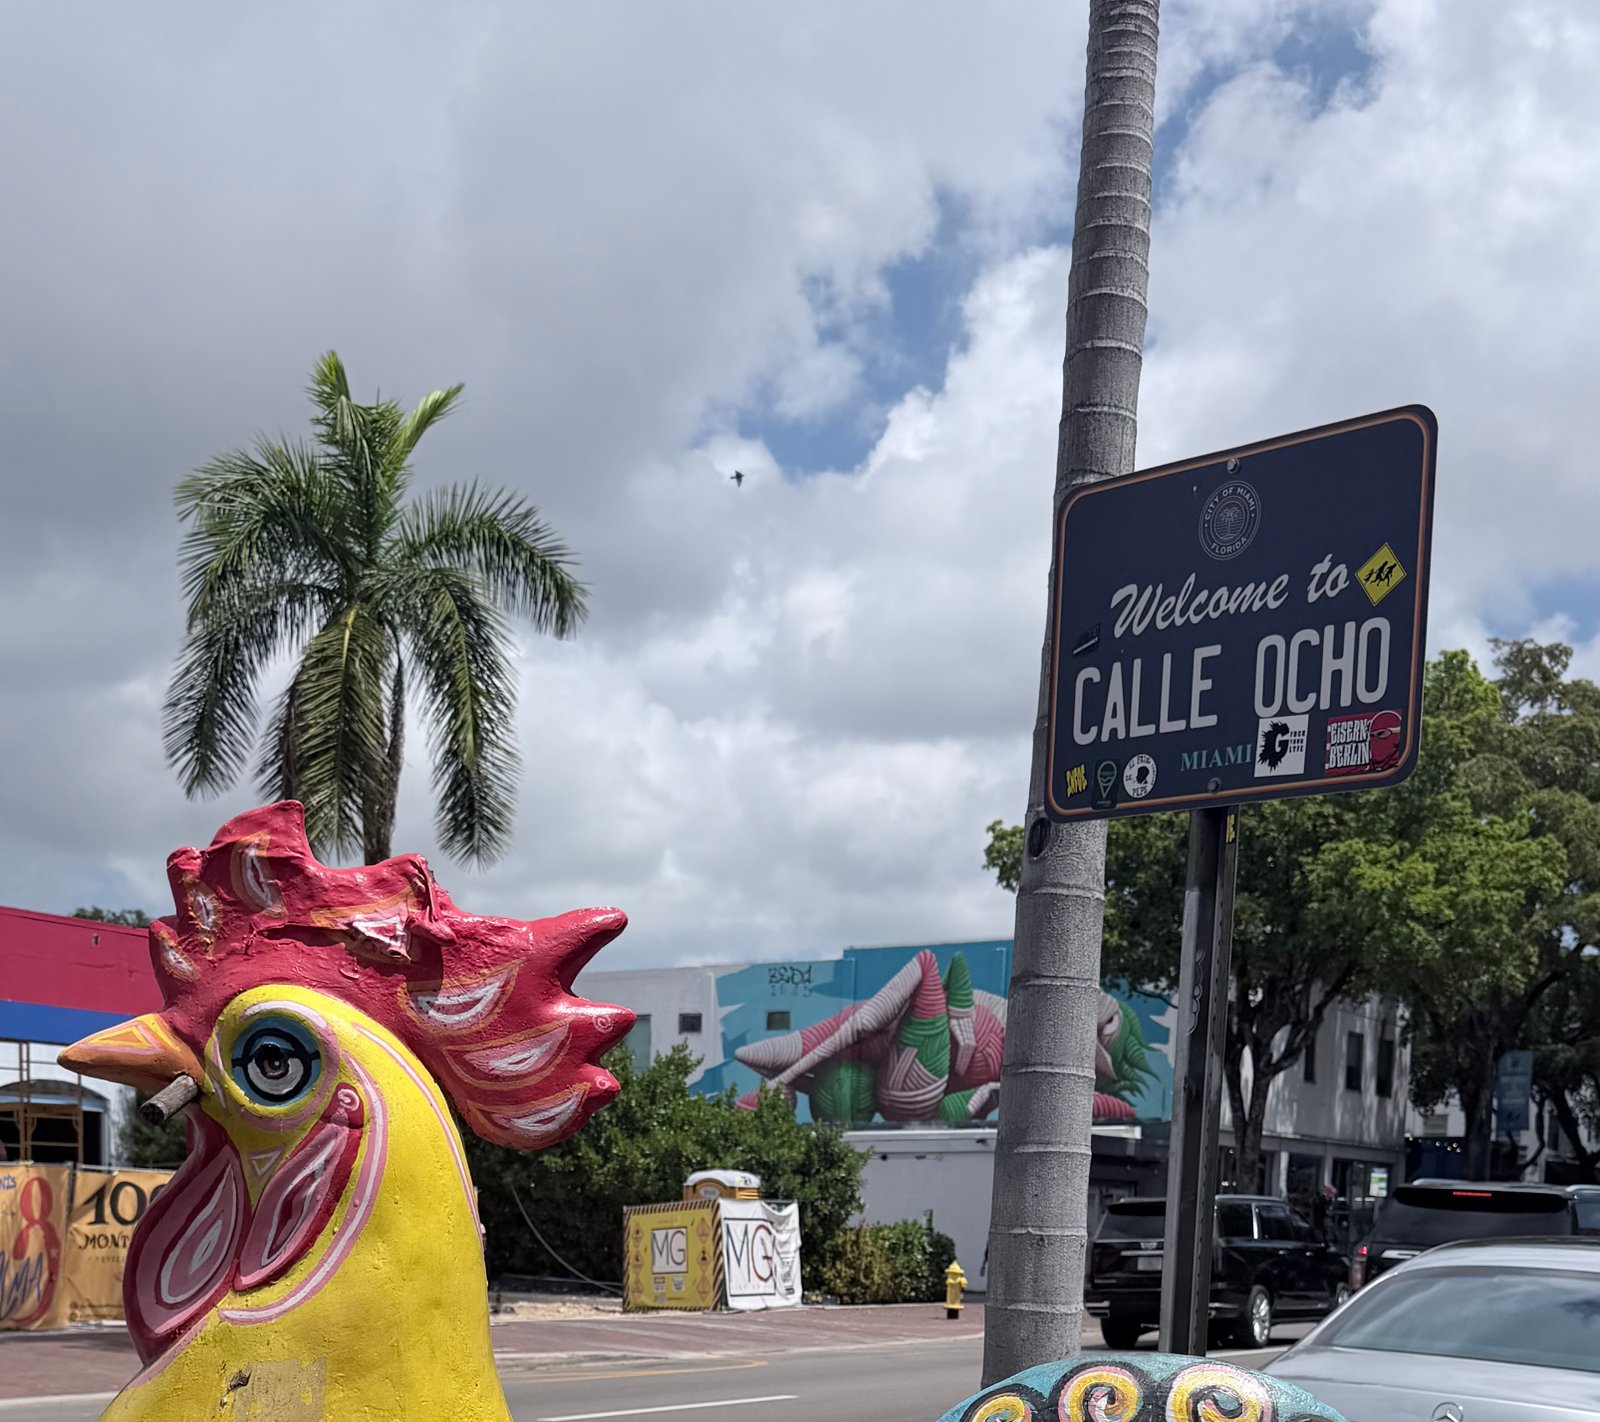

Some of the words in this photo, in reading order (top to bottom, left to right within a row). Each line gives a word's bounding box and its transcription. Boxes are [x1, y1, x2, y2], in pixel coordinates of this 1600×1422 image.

[1204, 496, 1219, 520] CITY
[1222, 487, 1234, 496] OF
[1236, 487, 1256, 510] MIAMI
[1211, 537, 1247, 554] FLORIDA
[1110, 573, 1289, 638] Welcome
[1307, 553, 1350, 602] to
[1073, 645, 1222, 745] CALLE
[1254, 617, 1391, 718] OCHO
[1180, 744, 1253, 771] MIAMI
[1329, 742, 1370, 769] BERLIN
[653, 1229, 686, 1266] MG
[727, 1222, 774, 1283] MG
